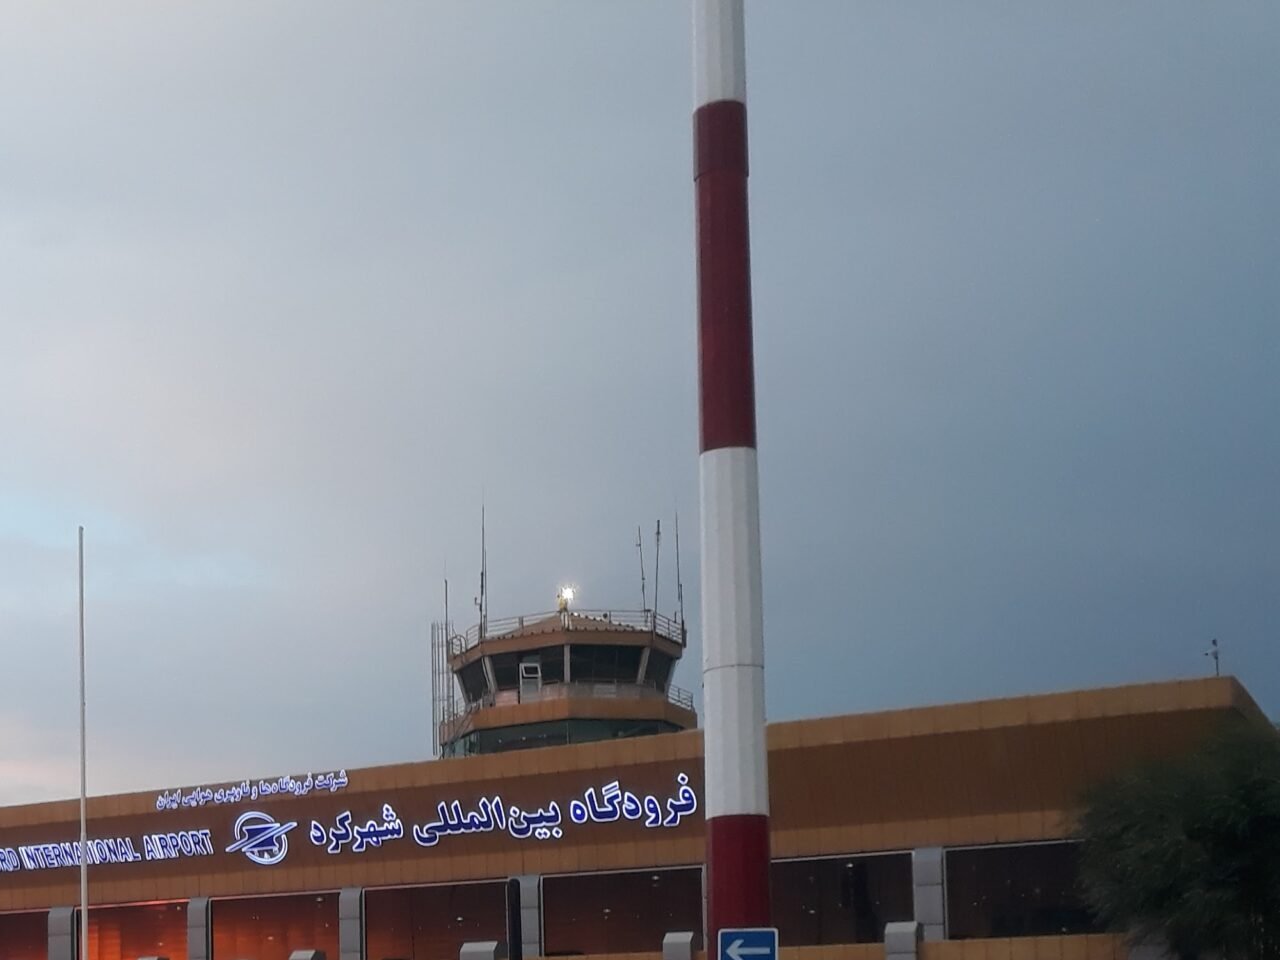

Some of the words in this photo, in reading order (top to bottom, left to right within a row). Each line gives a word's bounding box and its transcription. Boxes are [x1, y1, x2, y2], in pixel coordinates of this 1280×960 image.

[214, 779, 251, 804] ناوبری
[314, 769, 348, 792] شرکت
[156, 789, 181, 810] ایران
[183, 788, 213, 808] هوایی
[250, 787, 258, 800] و
[569, 772, 697, 827] فرودگاه
[310, 803, 404, 853] شهرکرد
[143, 829, 214, 860] AIRPORT
